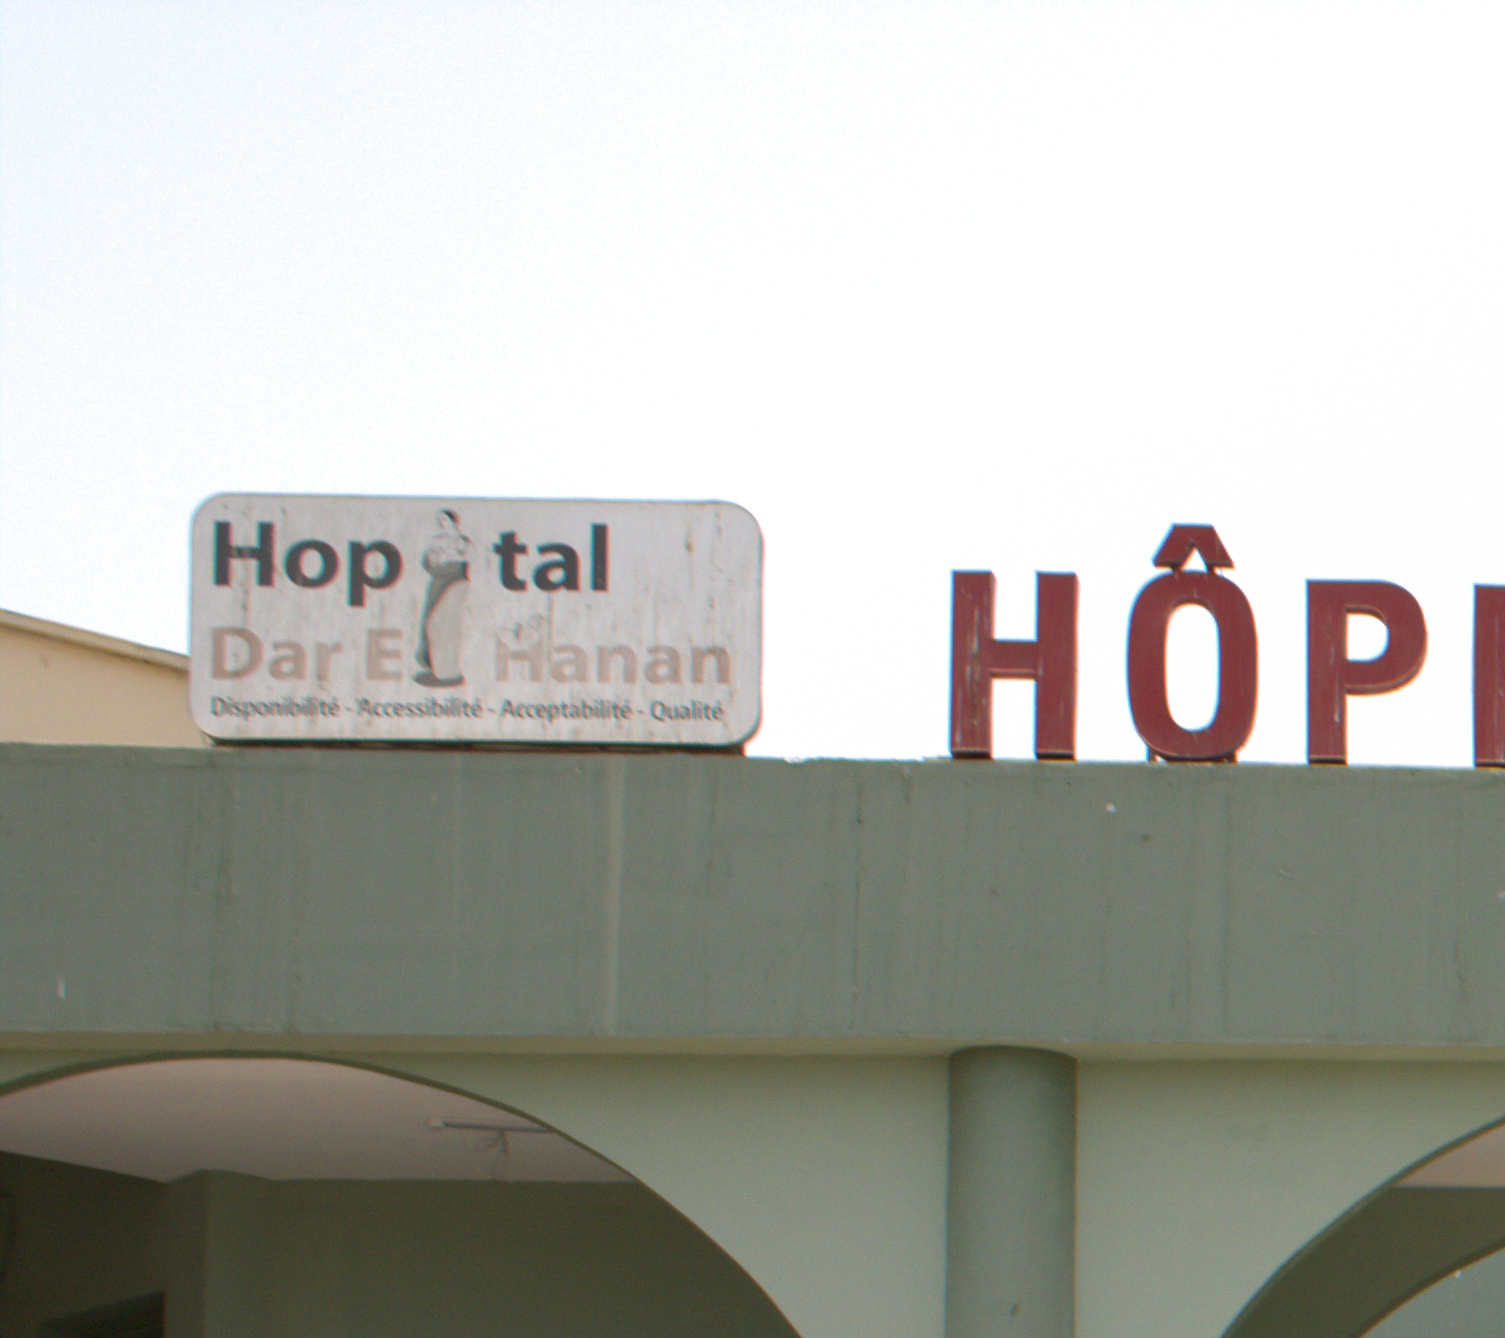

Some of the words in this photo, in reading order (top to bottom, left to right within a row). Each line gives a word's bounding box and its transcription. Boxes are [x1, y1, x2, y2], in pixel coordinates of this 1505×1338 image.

[211, 627, 345, 681] Dar
[496, 633, 730, 686] Hanan
[211, 696, 341, 720] Disponibilité
[356, 697, 483, 718] Accessibilité
[500, 698, 633, 723] Acceptabilité
[650, 699, 725, 723] Qualité
